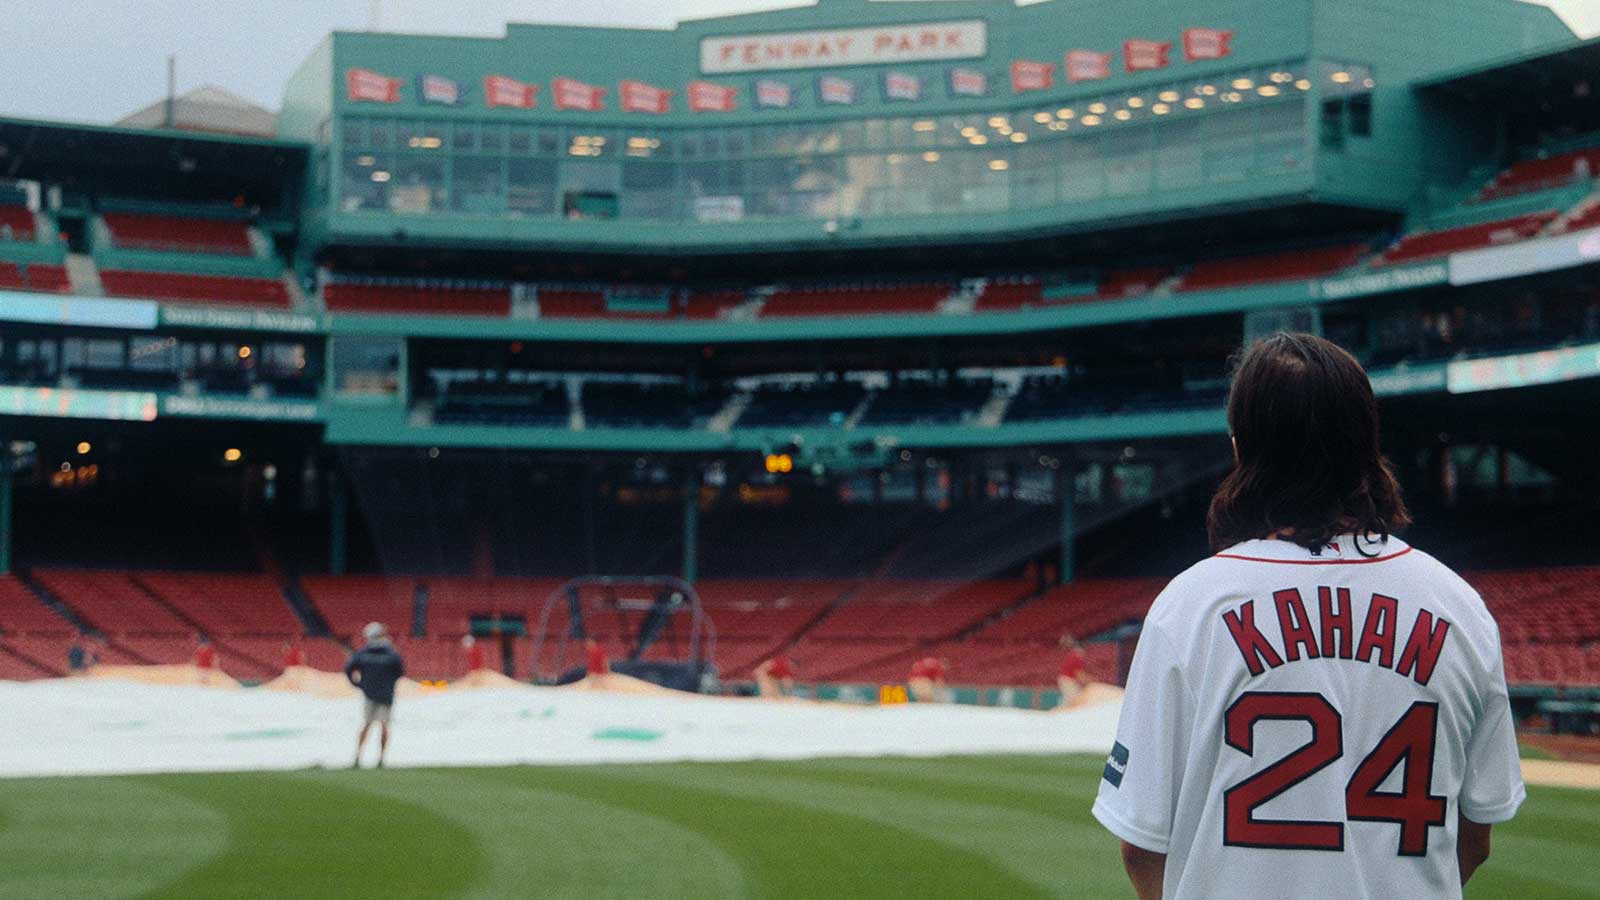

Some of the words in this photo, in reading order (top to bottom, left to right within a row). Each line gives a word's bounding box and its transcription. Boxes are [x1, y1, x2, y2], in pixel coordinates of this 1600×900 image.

[720, 36, 853, 63] FENWAY
[873, 31, 963, 54] PARK
[1222, 586, 1450, 686] KAHAN
[1223, 691, 1447, 857] 24
